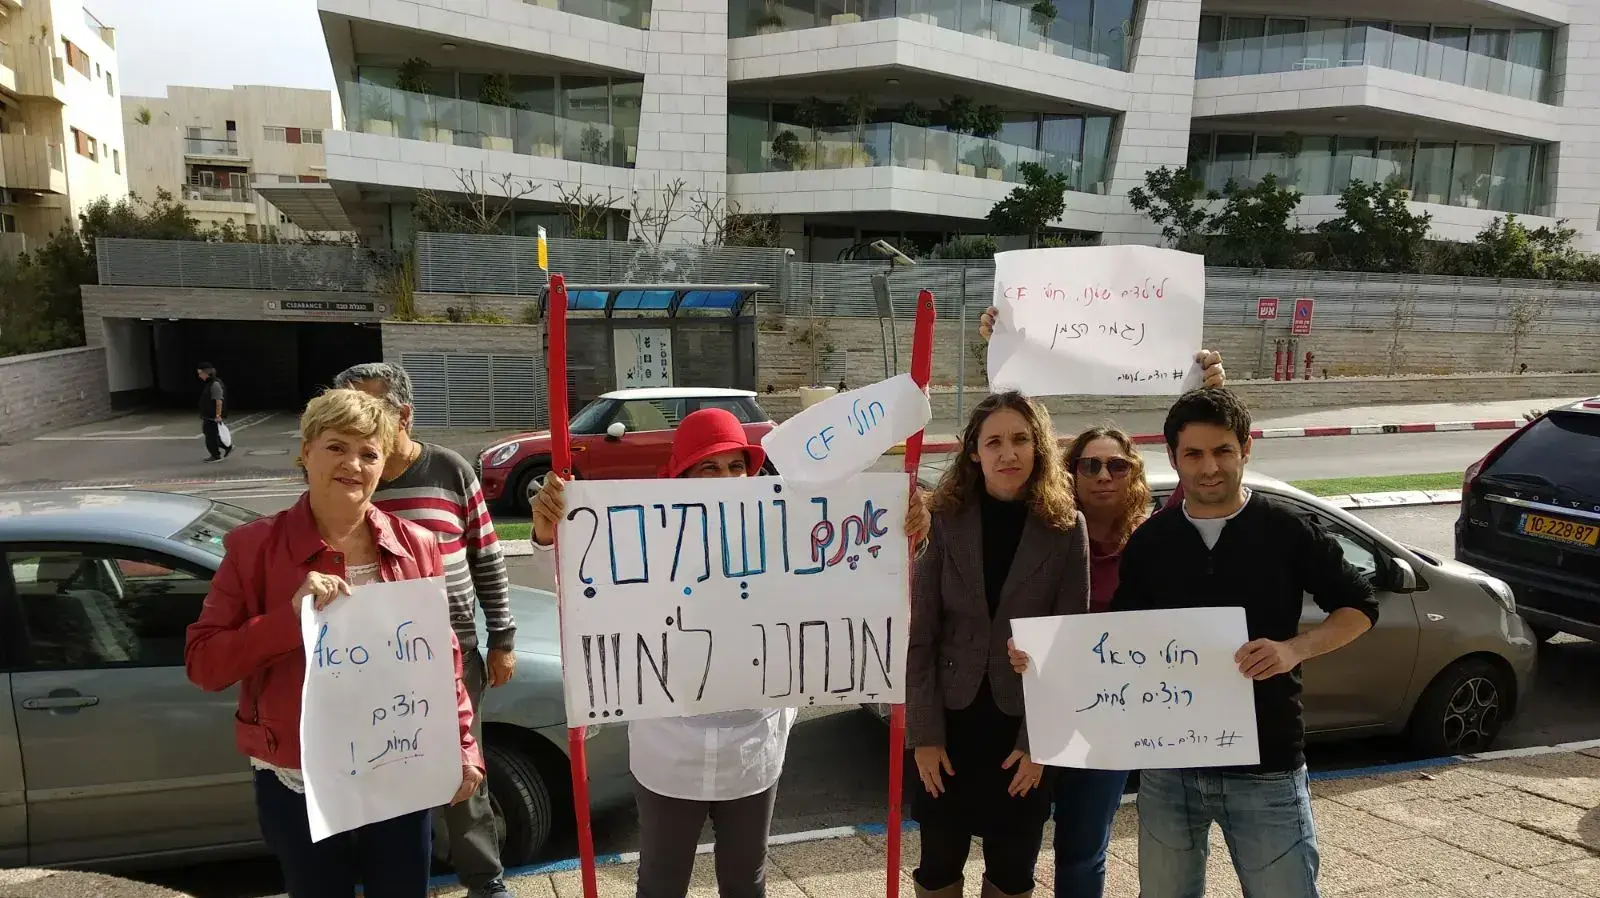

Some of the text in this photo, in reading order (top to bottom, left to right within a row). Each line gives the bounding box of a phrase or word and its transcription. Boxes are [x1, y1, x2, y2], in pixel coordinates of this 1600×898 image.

[1260, 306, 1275, 316] אש
[1050, 322, 1145, 350] נגמר הזמן
[806, 398, 885, 460] חולי CF
